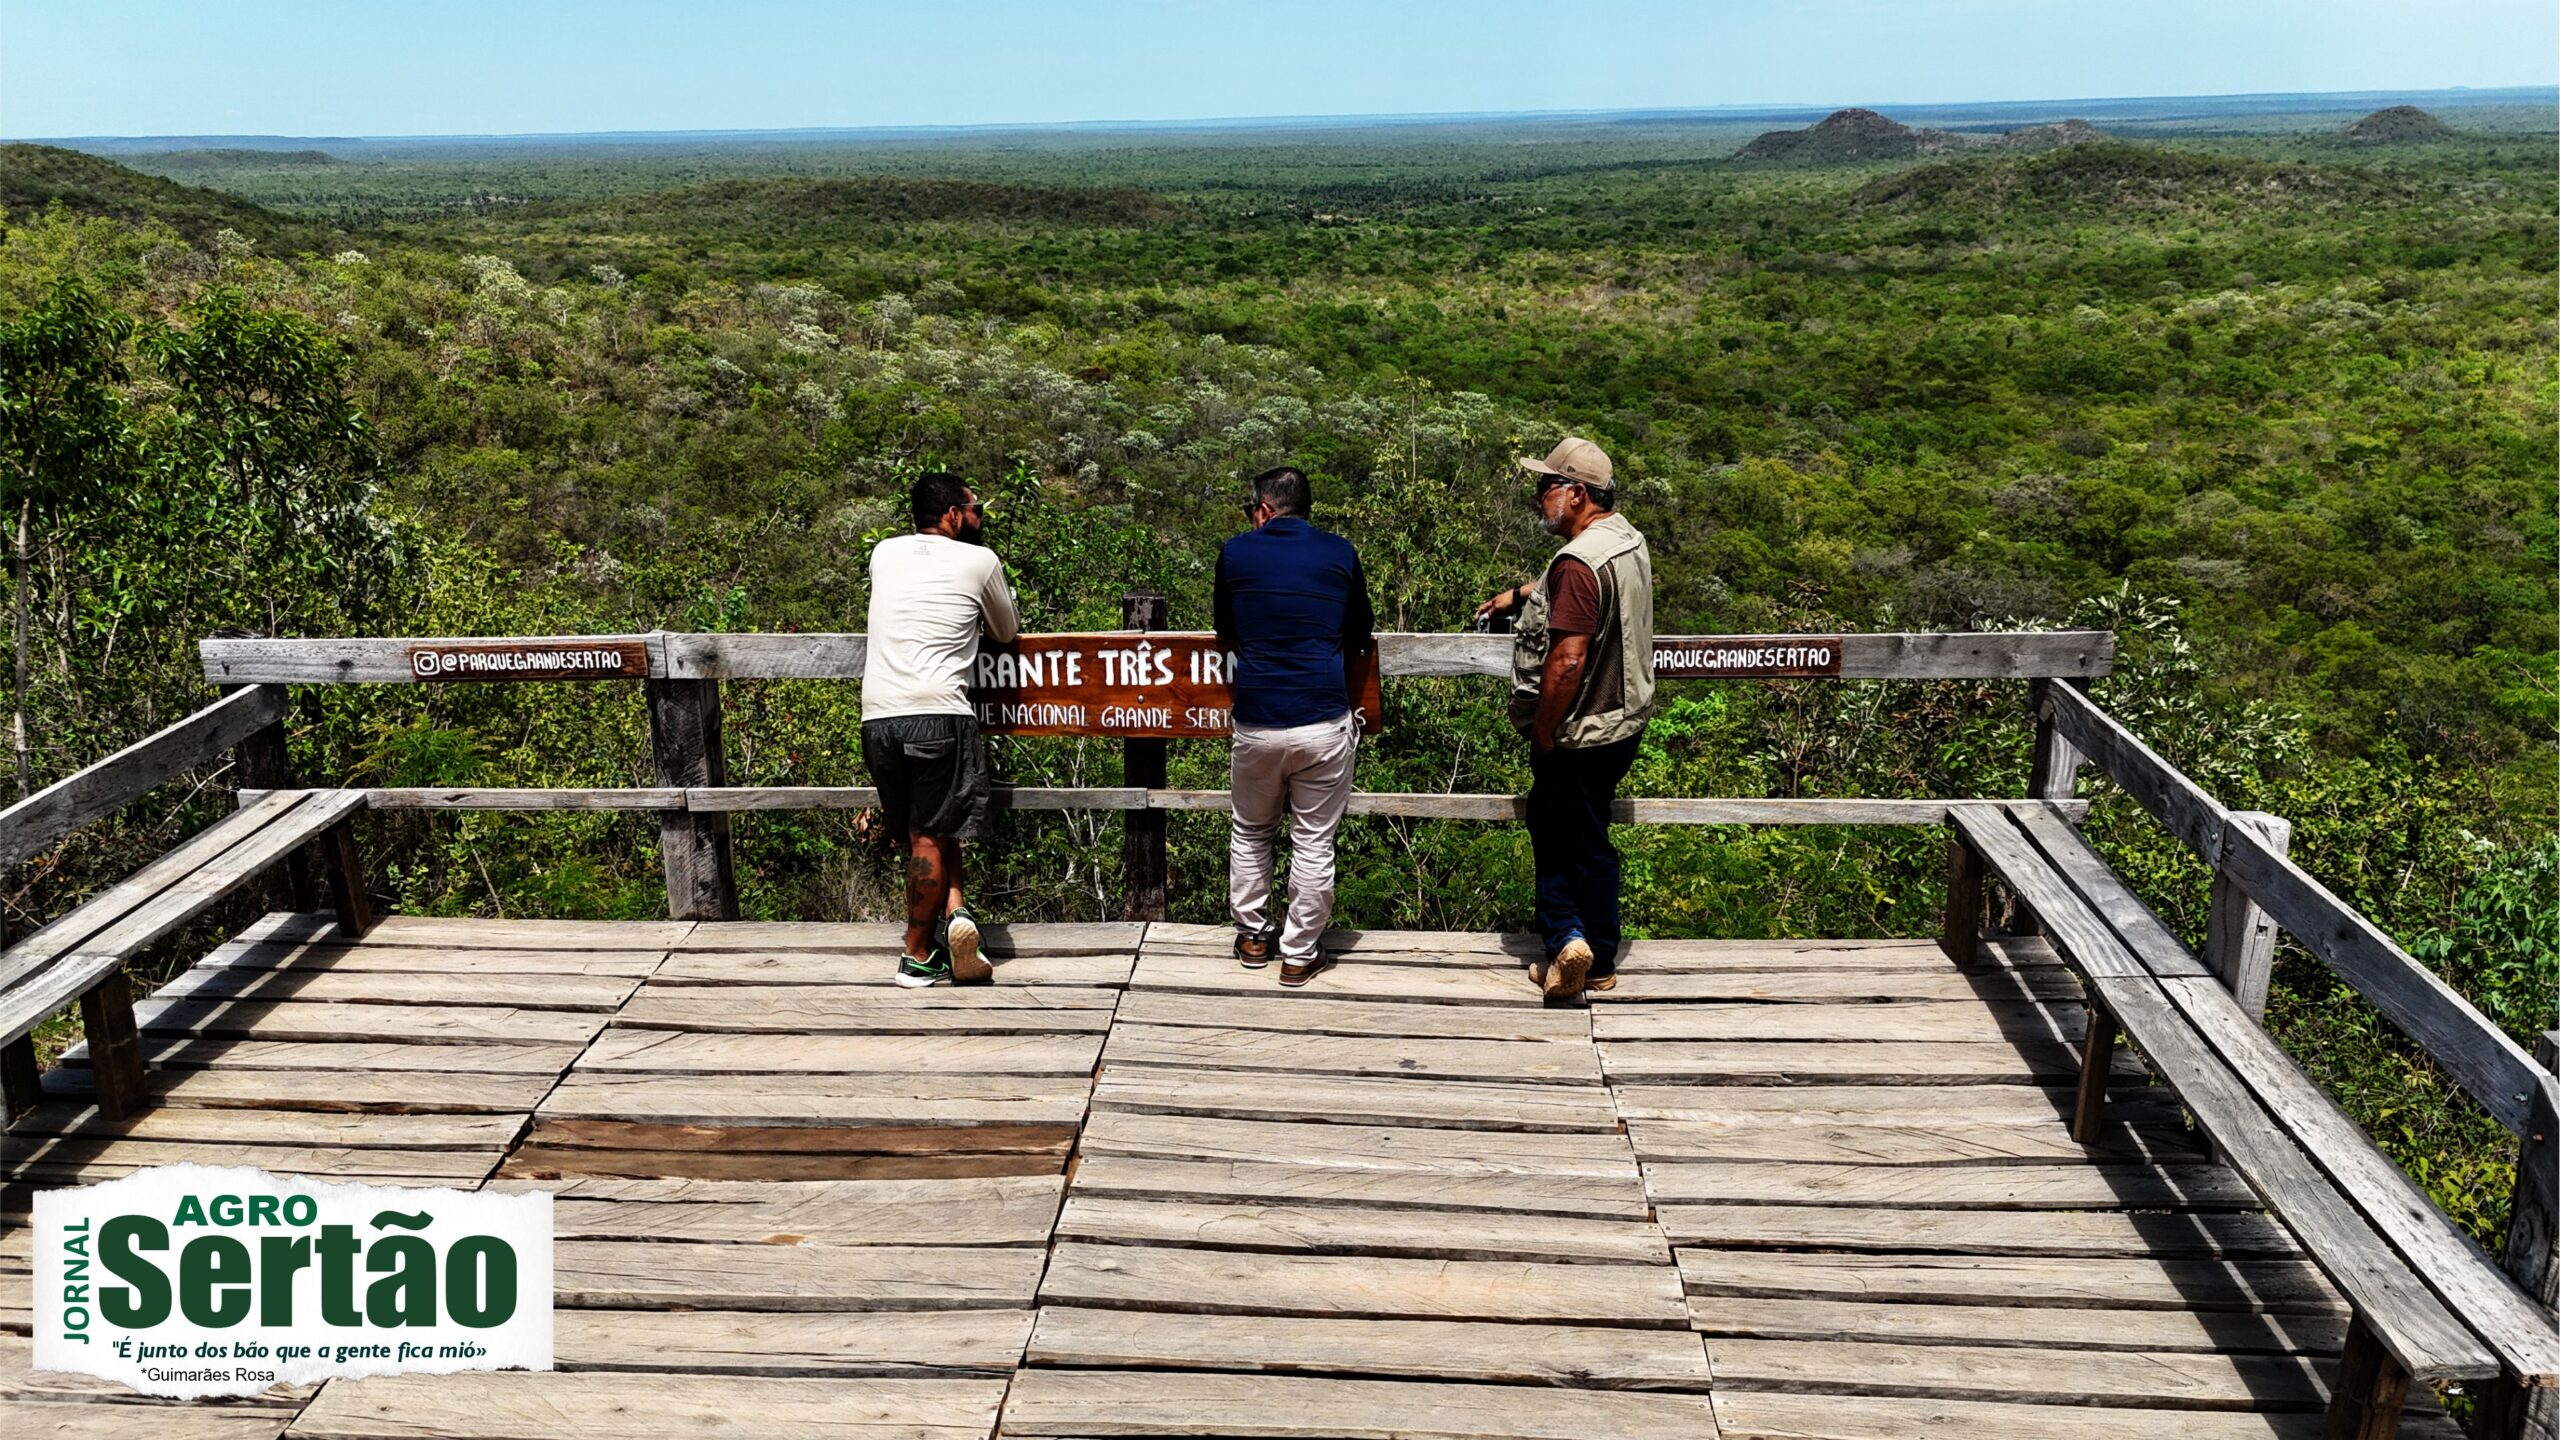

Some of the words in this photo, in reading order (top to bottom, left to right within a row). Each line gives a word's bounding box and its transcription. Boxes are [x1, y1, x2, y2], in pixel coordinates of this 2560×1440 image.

[441, 650, 622, 672] @PARQUEGRANDESERTAO
[968, 650, 1083, 688] IRANTE
[1097, 639, 1174, 686] TRÊS
[1652, 647, 1831, 670] ARQUEGRANDESERTAO
[1002, 703, 1088, 727] NACIONAL
[1101, 705, 1173, 729] GRANDE
[1185, 706, 1230, 729] SERT
